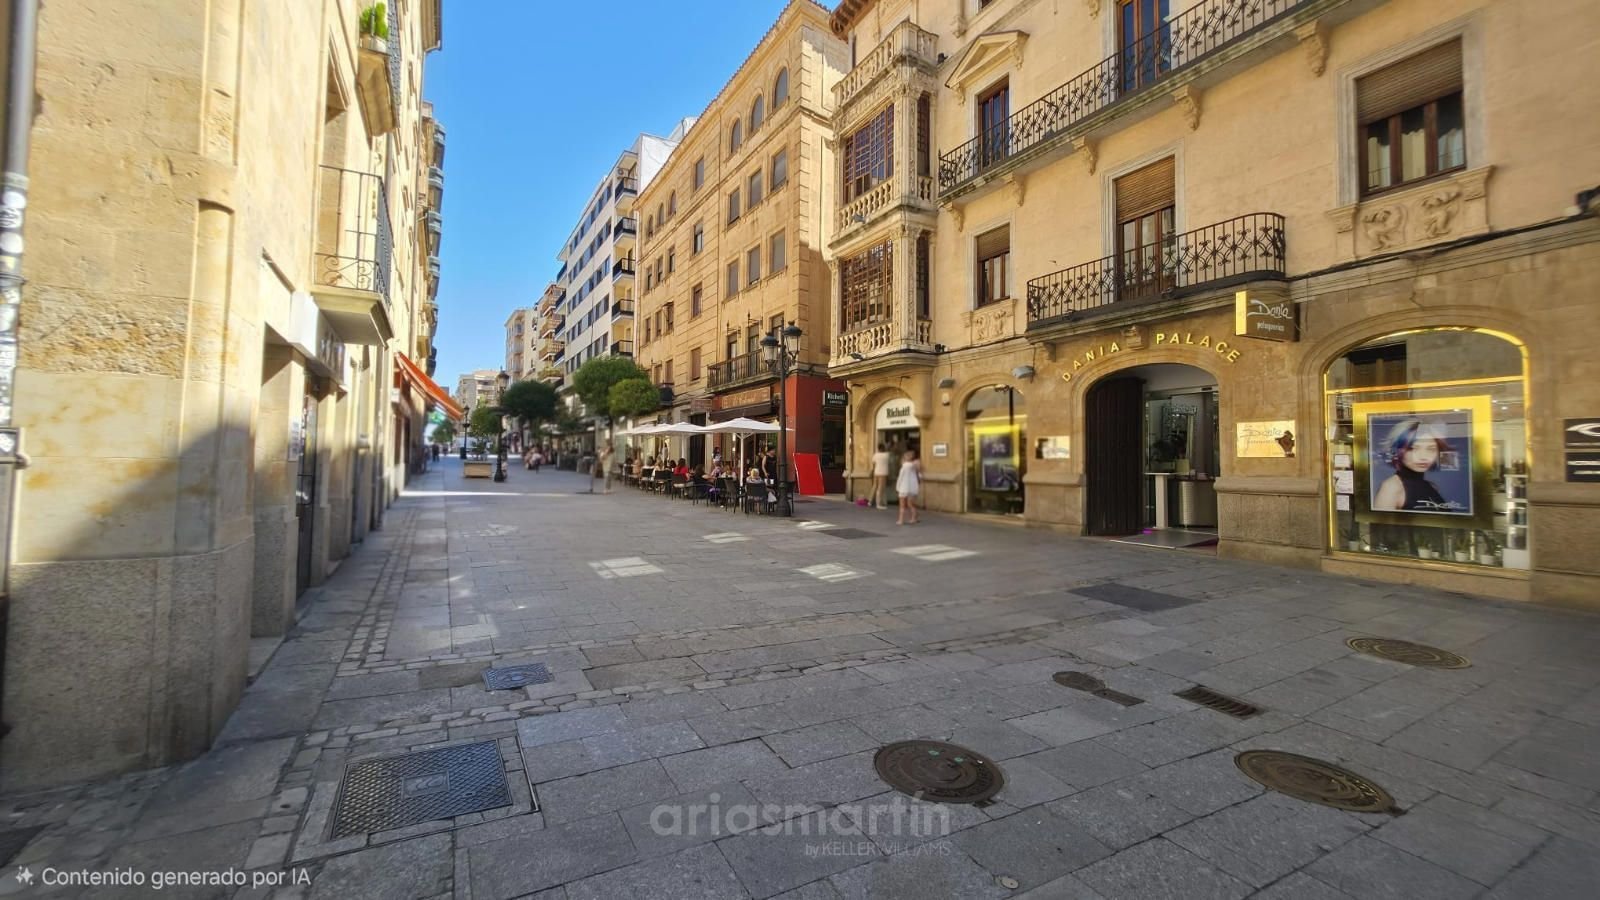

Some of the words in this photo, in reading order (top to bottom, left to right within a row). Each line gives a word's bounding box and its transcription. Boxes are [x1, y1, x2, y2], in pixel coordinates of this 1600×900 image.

[1247, 299, 1293, 319] Dania
[1062, 341, 1121, 382] DANIA
[1156, 332, 1241, 363] PALACE
